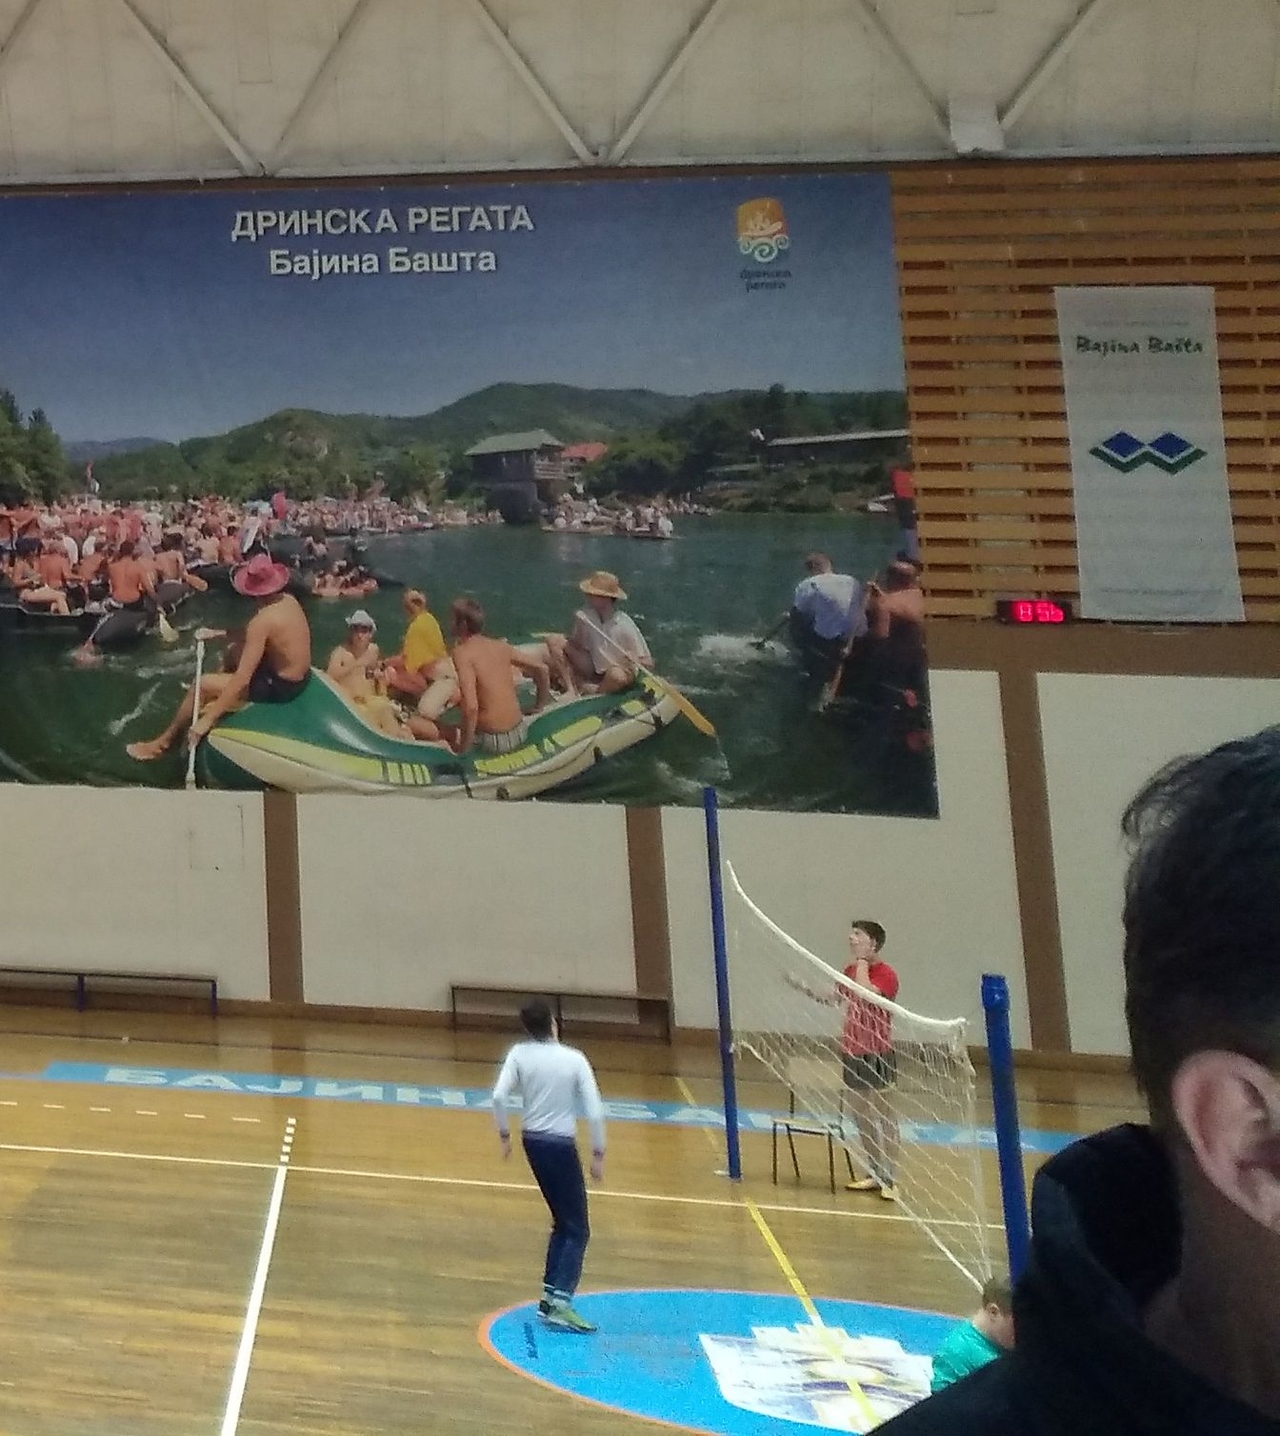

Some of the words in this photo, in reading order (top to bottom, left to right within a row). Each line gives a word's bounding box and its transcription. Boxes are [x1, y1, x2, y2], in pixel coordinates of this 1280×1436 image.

[231, 208, 398, 242] ДРИНСКА
[408, 204, 535, 233] РЕГАТА
[269, 248, 380, 280] Бајина
[389, 246, 497, 273] Башта
